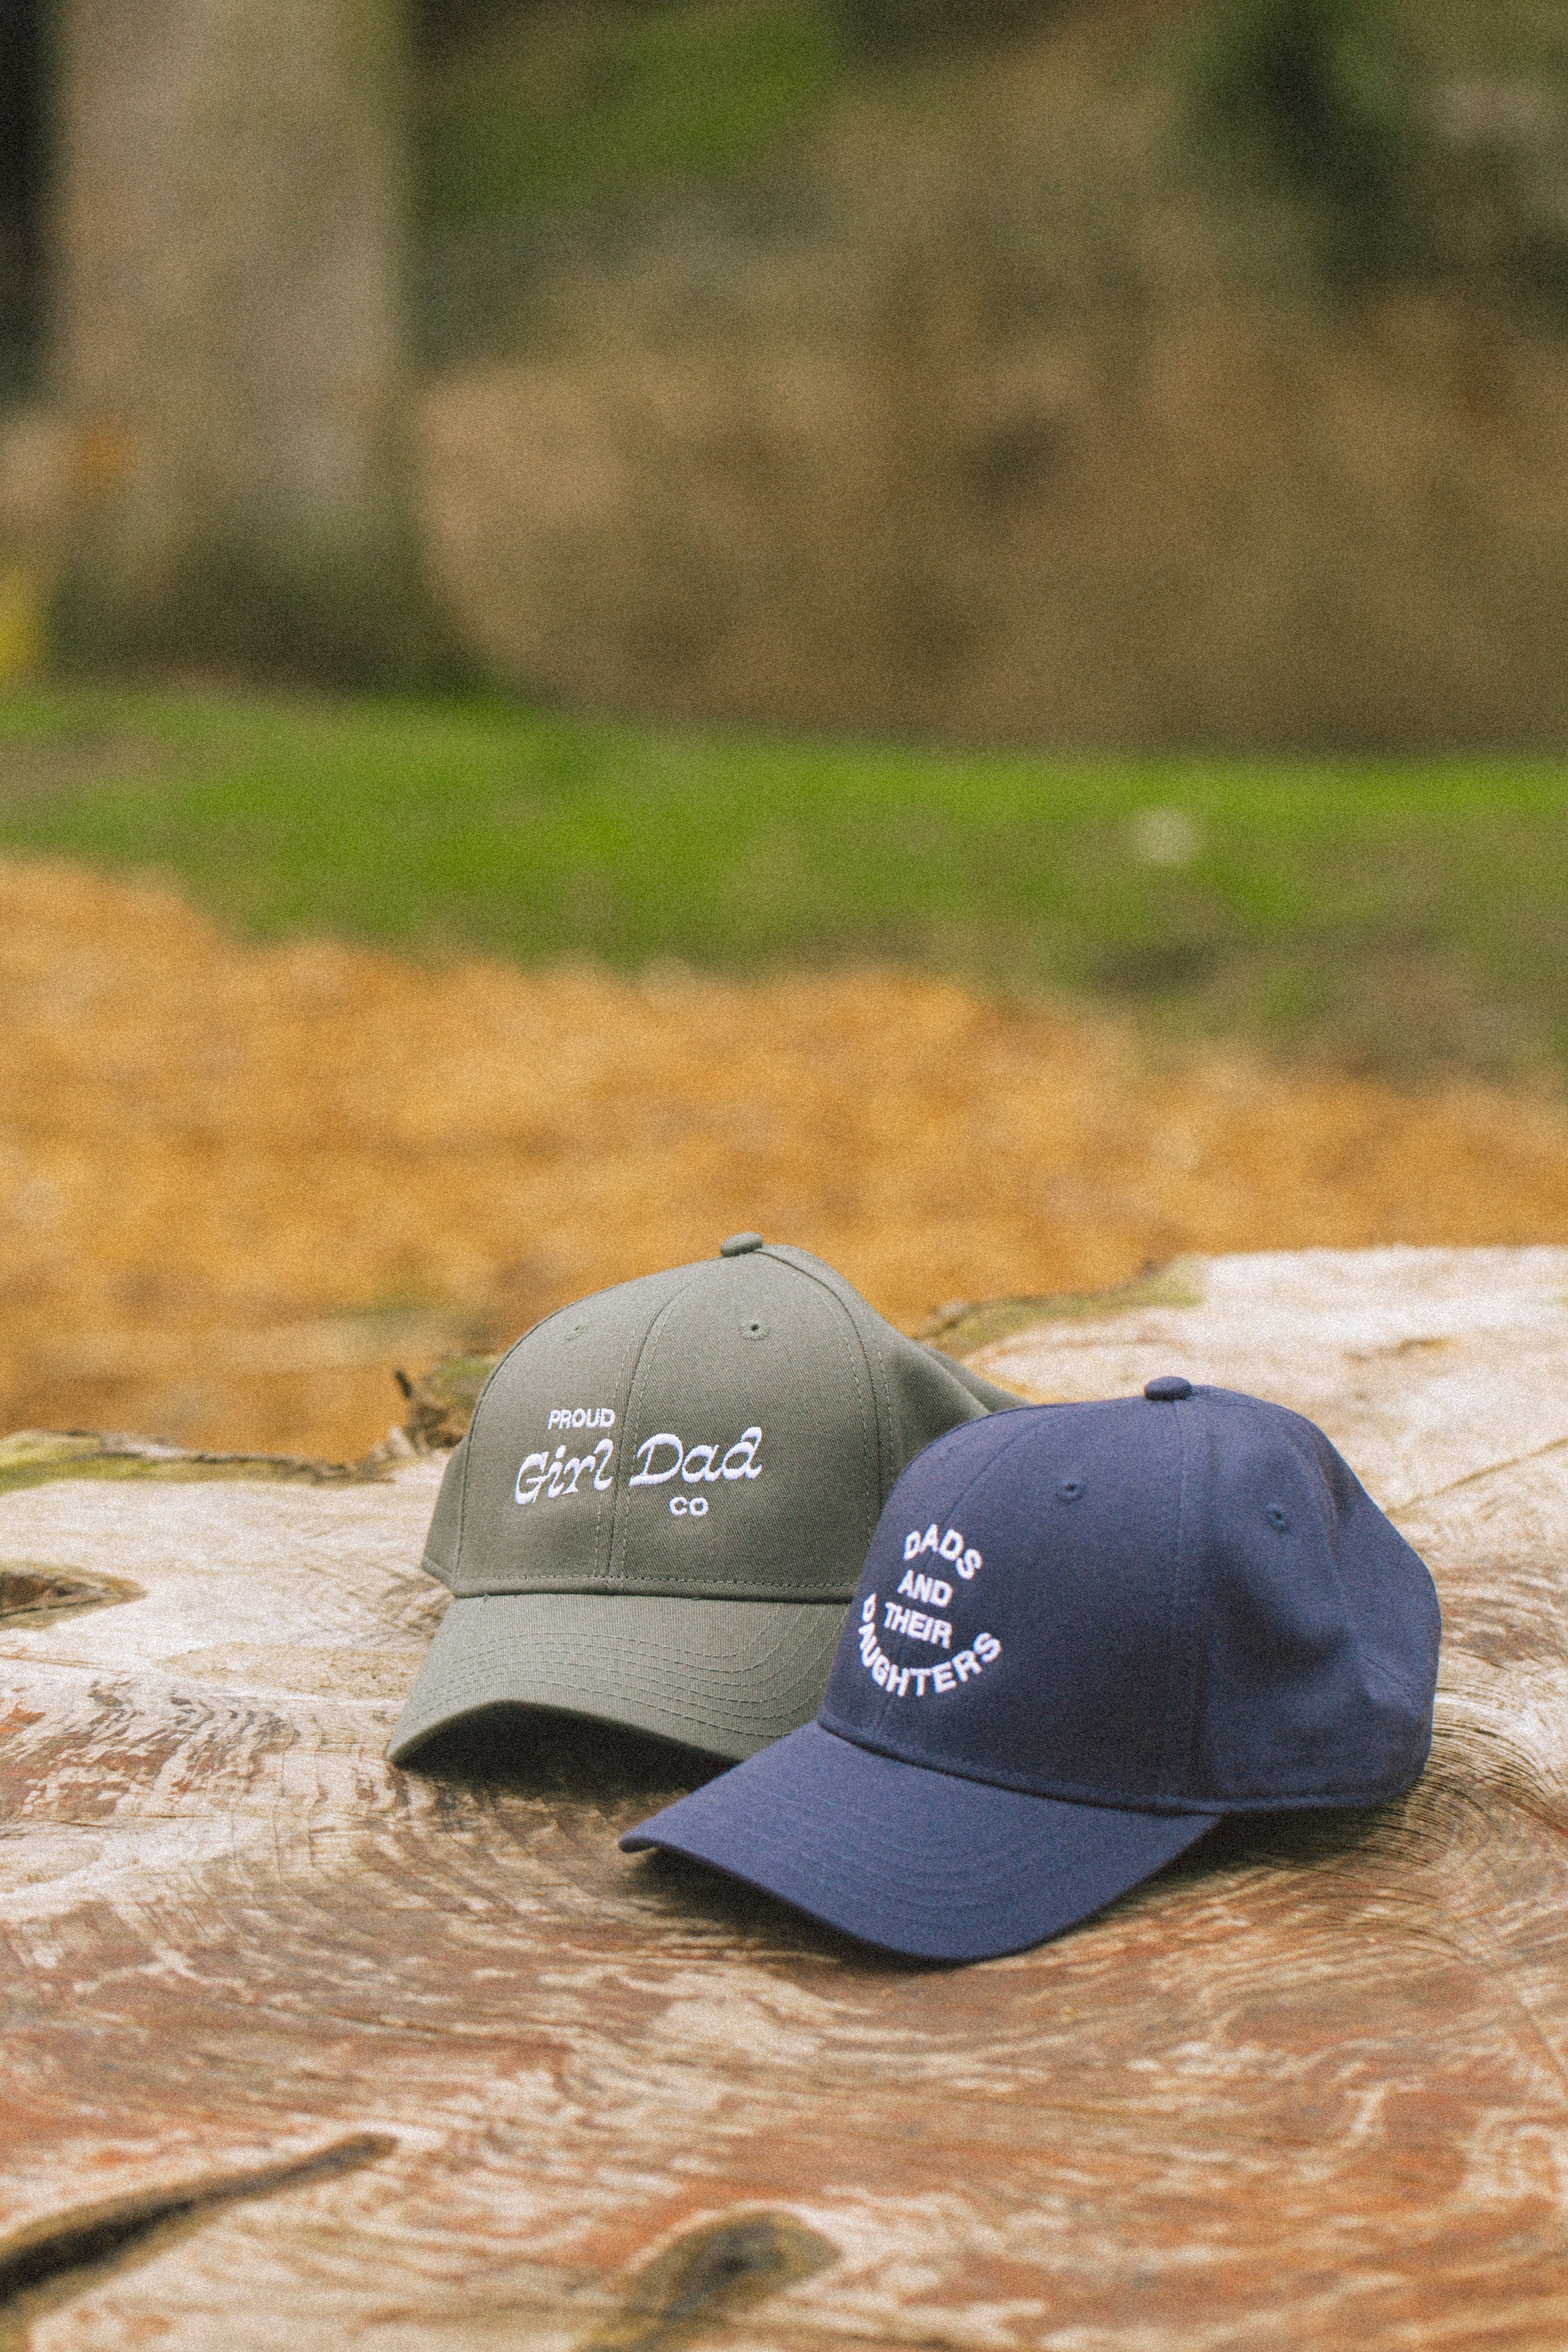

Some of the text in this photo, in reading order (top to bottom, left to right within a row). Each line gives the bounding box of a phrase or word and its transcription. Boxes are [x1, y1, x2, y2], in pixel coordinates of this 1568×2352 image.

[547, 1408, 616, 1430] PROUD
[514, 1426, 763, 1505] Girl Dad
[669, 1496, 708, 1517] CO
[903, 1523, 983, 1580] DADS
[897, 1569, 954, 1608] AND
[858, 1592, 1002, 1697] DAUGHTERS
[882, 1602, 953, 1650] THEIR
